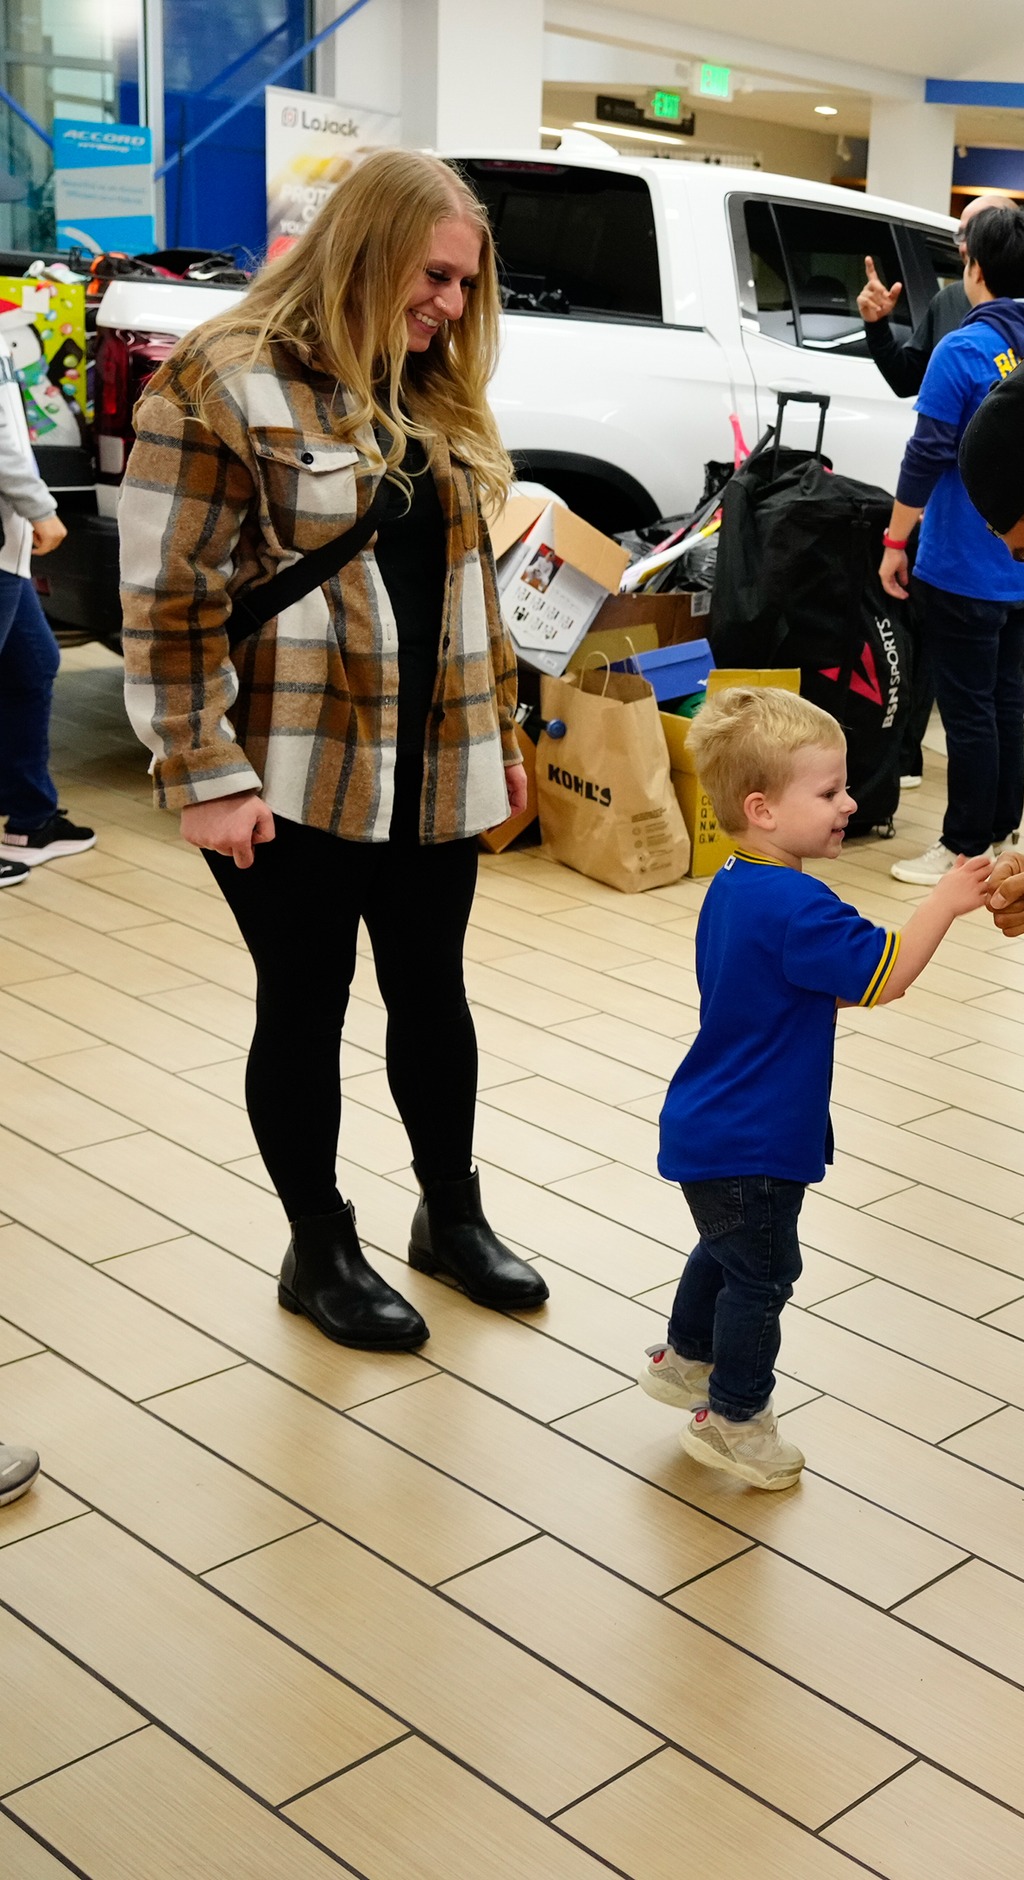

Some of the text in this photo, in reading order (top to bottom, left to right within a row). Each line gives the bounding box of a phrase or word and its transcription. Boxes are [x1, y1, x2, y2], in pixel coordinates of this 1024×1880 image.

[63, 129, 146, 147] ACCORD
[876, 618, 901, 729] BSN SPORTS
[547, 763, 612, 808] KOHL'S
